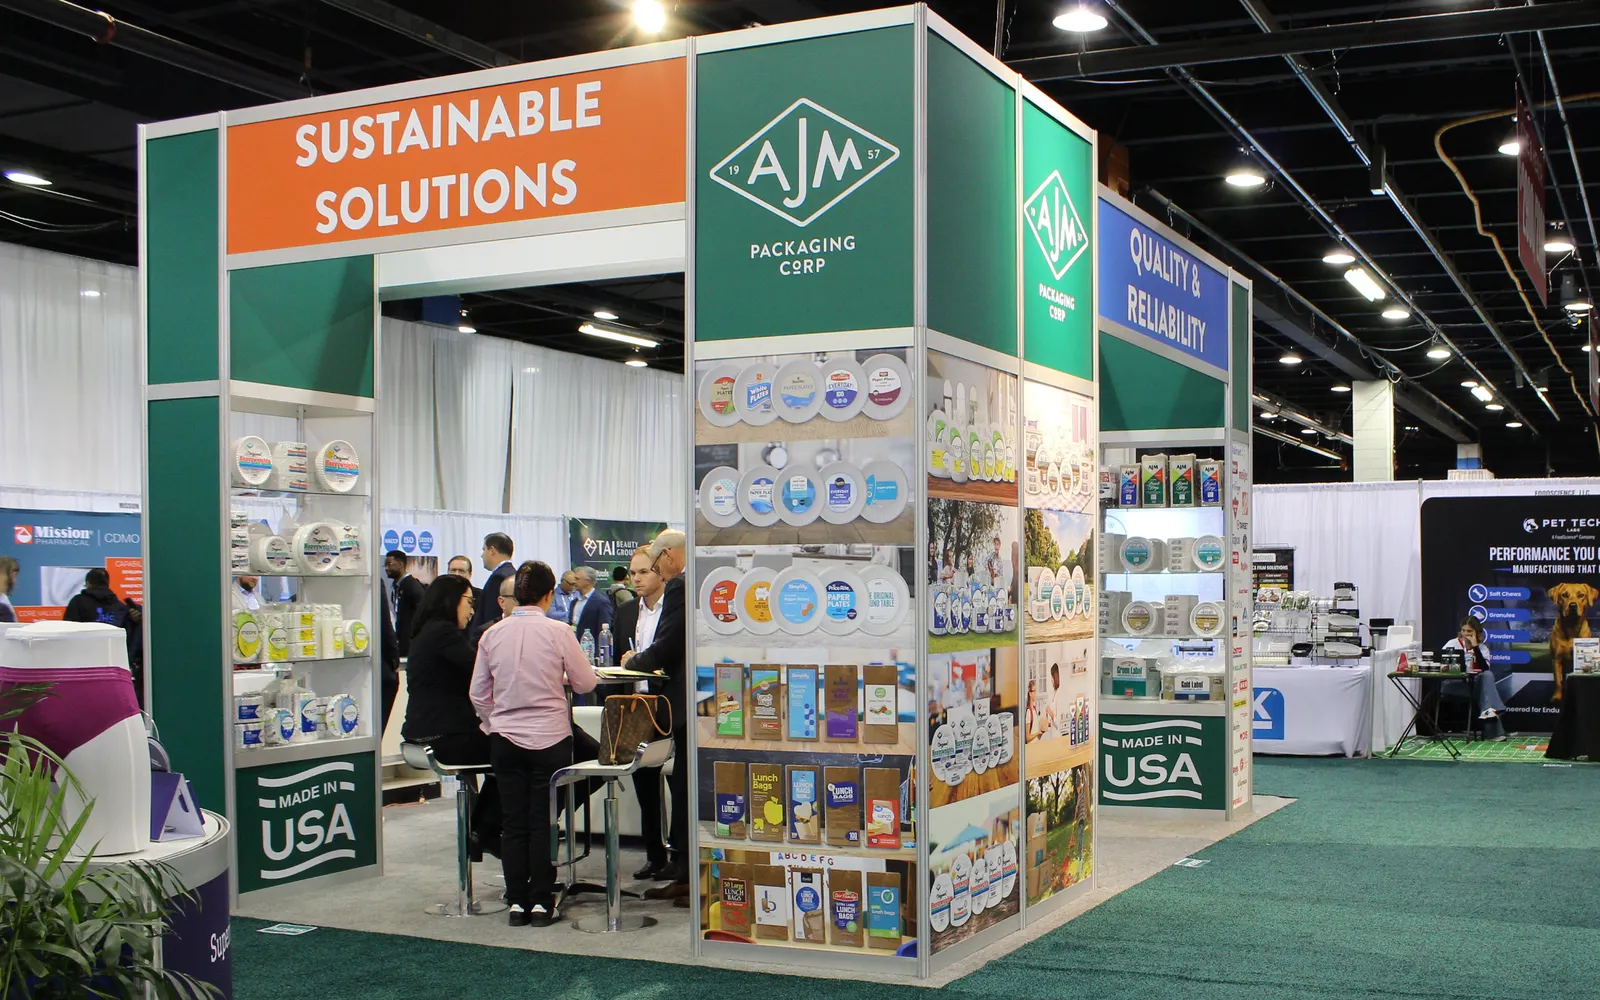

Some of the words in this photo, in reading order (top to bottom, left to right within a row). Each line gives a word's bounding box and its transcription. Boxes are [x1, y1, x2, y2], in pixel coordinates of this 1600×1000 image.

[295, 80, 602, 167] SUSTAINABLE
[728, 165, 739, 175] 19
[747, 117, 862, 208] AJM
[867, 149, 881, 159] 57
[315, 159, 577, 234] SOLUTIONS
[1037, 186, 1077, 263] AJM
[750, 235, 856, 258] PACKAGING
[779, 258, 826, 276] CORP
[1130, 227, 1189, 291] QUALITY
[1191, 263, 1201, 299] &
[1039, 282, 1075, 310] PACKAGING
[1049, 305, 1066, 323] CORP
[1128, 284, 1206, 353] RELIABILITY
[750, 385, 768, 395] White
[750, 390, 769, 403] PLATES
[1542, 518, 1566, 527] PET
[1571, 518, 1600, 527] TECH
[34, 526, 90, 539] Mission
[104, 533, 140, 543] CDMO
[403, 536, 414, 544] ISO
[596, 540, 615, 556] TAI
[1489, 546, 1571, 561] PERFORMANCE
[1573, 546, 1595, 561] YOU
[1512, 564, 1575, 574] MANUFACTURING
[1577, 564, 1596, 573] THAT
[1116, 666, 1129, 674] Green
[1130, 666, 1143, 674] Label
[1121, 735, 1164, 748] MADE
[1168, 734, 1182, 745] IN
[1104, 752, 1203, 787] USA
[752, 772, 778, 782] Lunch
[752, 781, 772, 791] Bags
[833, 786, 853, 794] LUNCH
[279, 785, 321, 809] MADE
[323, 781, 337, 795] IN
[261, 803, 356, 861] USA
[849, 832, 858, 840] 100
[778, 852, 784, 860] A
[828, 857, 834, 866] G
[724, 888, 744, 896] LUNCH
